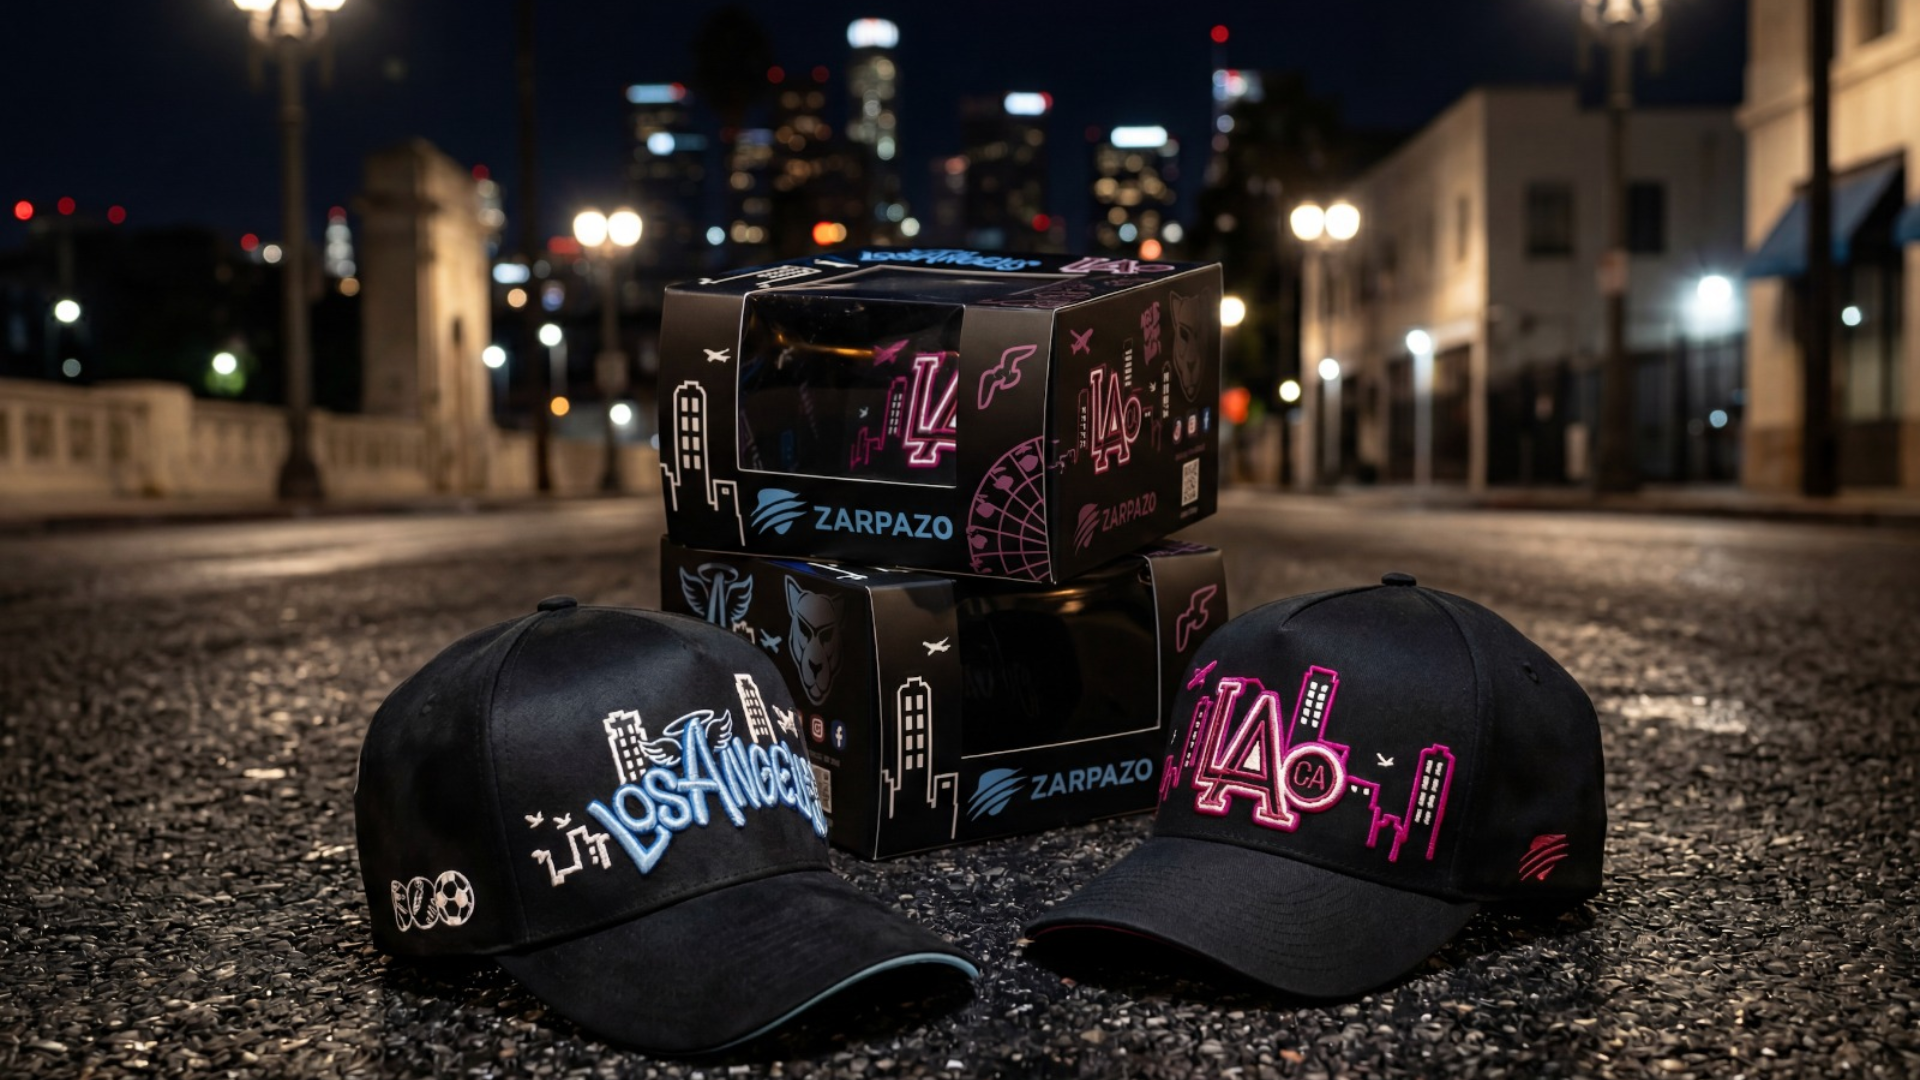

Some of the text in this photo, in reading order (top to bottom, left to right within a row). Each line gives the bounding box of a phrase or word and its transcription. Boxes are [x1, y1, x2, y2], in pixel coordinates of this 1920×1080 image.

[1089, 364, 1131, 475] LA
[813, 505, 953, 541] ZARPAZO
[1101, 491, 1157, 532] ZARPAZO
[1192, 677, 1300, 833] LA
[1292, 760, 1326, 791] CA
[1031, 757, 1154, 801] ZARPAZO
[585, 764, 693, 876] LOS
